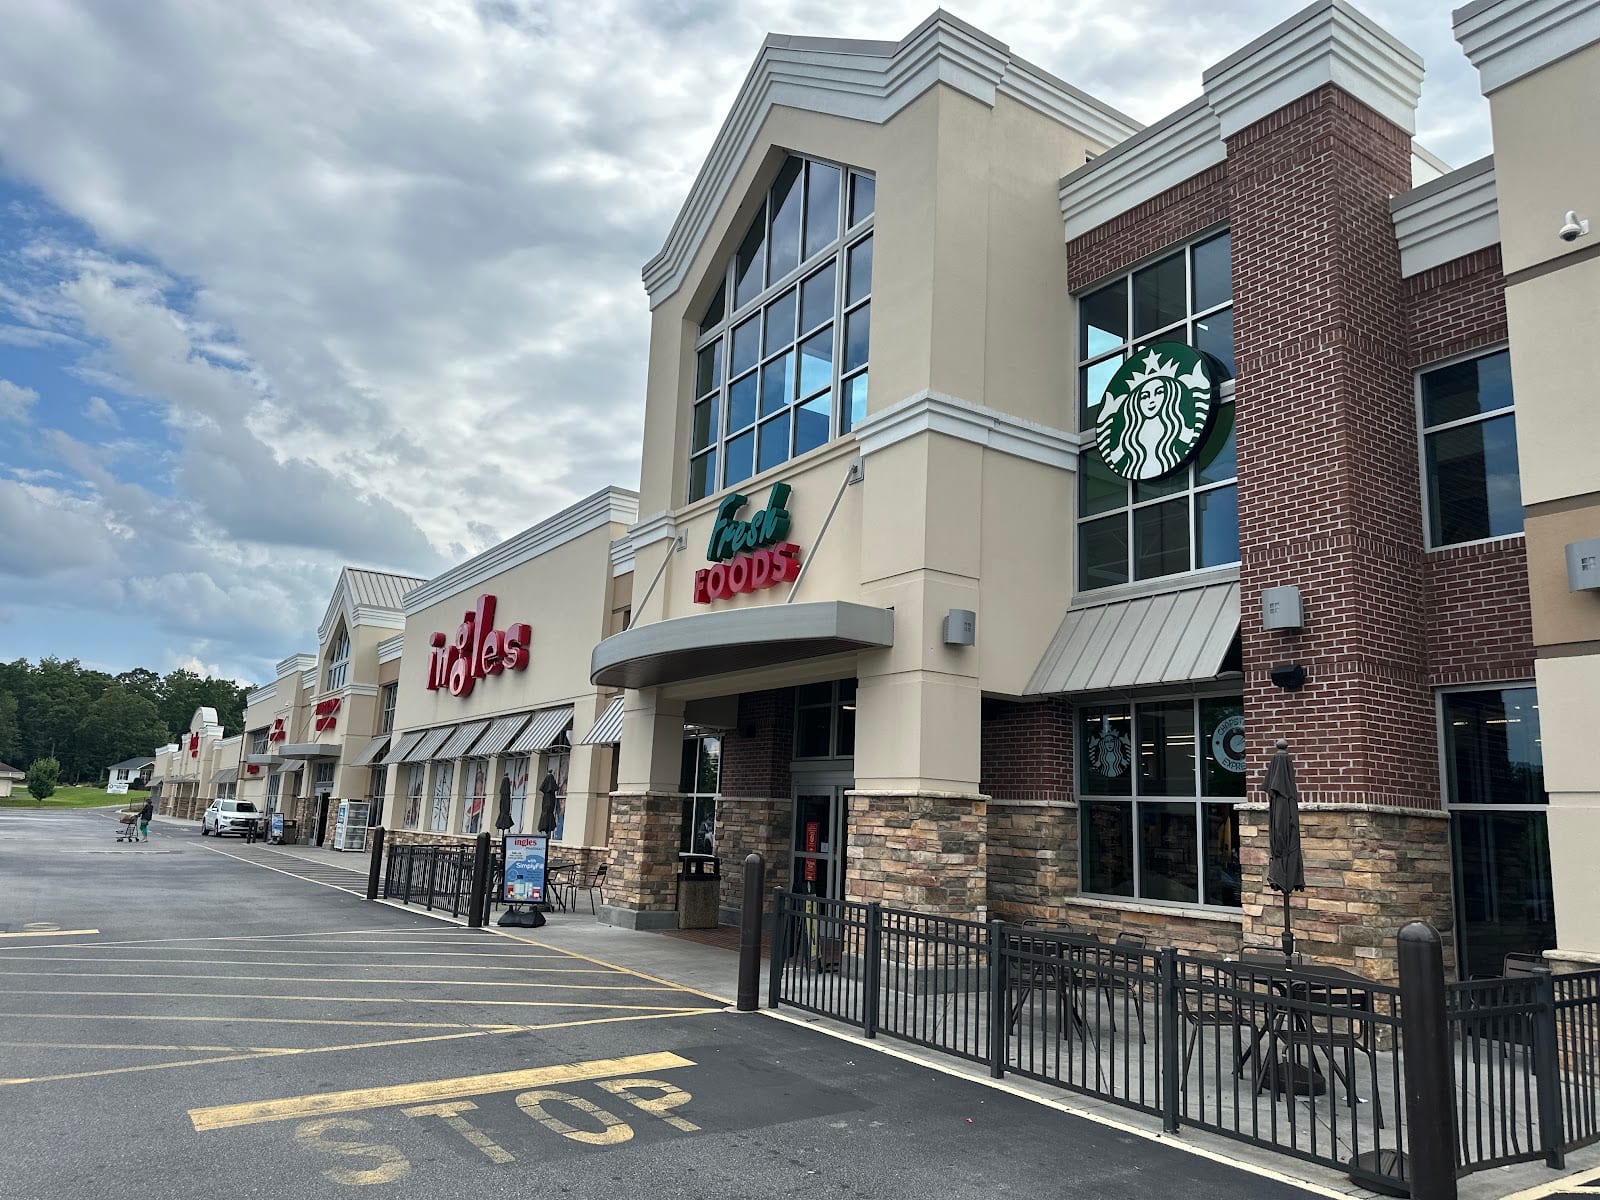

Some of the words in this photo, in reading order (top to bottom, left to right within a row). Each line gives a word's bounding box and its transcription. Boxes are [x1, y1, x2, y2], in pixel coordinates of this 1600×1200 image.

[707, 481, 791, 563] Fresh
[694, 542, 801, 604] FOODS
[426, 594, 532, 698] ingles
[1218, 718, 1244, 735] CHOPST
[1222, 758, 1246, 770] EXPRE
[514, 838, 537, 847] ingles
[294, 1077, 702, 1187] STOP
